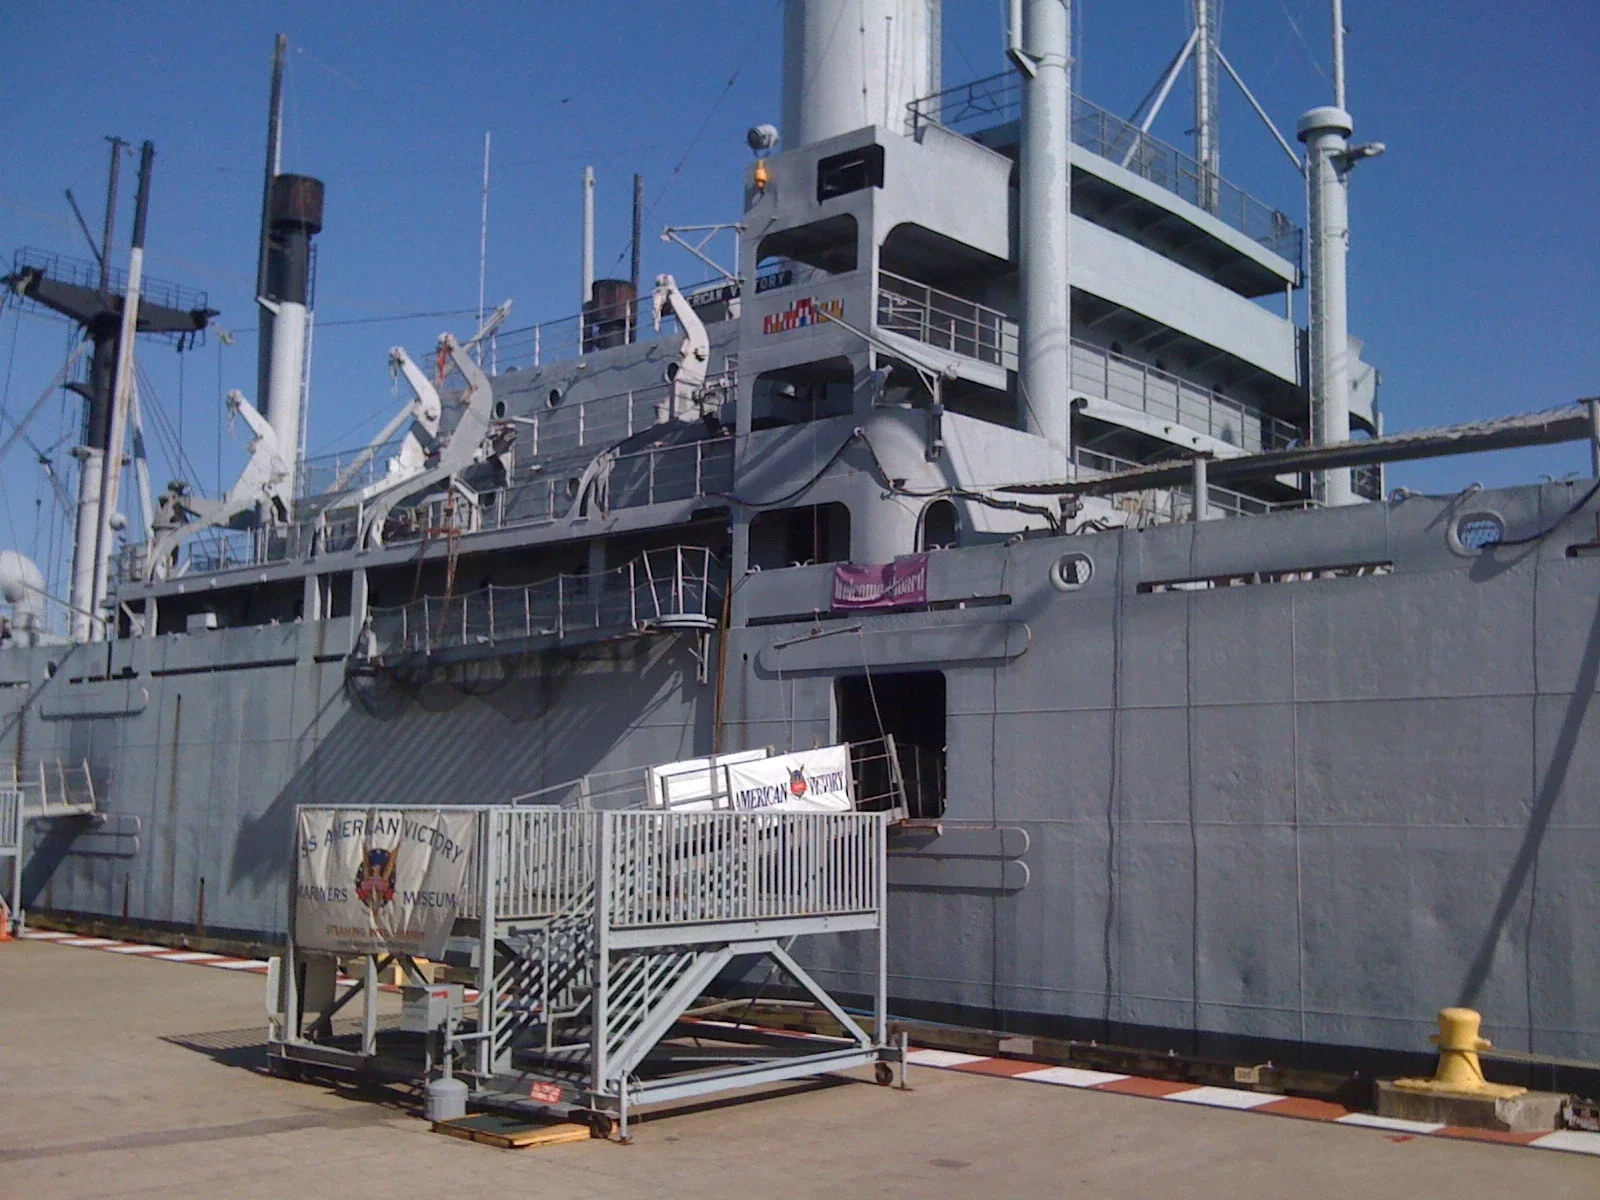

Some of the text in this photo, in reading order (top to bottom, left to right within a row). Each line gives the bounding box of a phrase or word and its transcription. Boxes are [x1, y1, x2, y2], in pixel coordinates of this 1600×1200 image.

[735, 781, 788, 809] AMERICAN
[404, 818, 464, 864] VICTORY
[403, 890, 457, 909] MUSEUM
